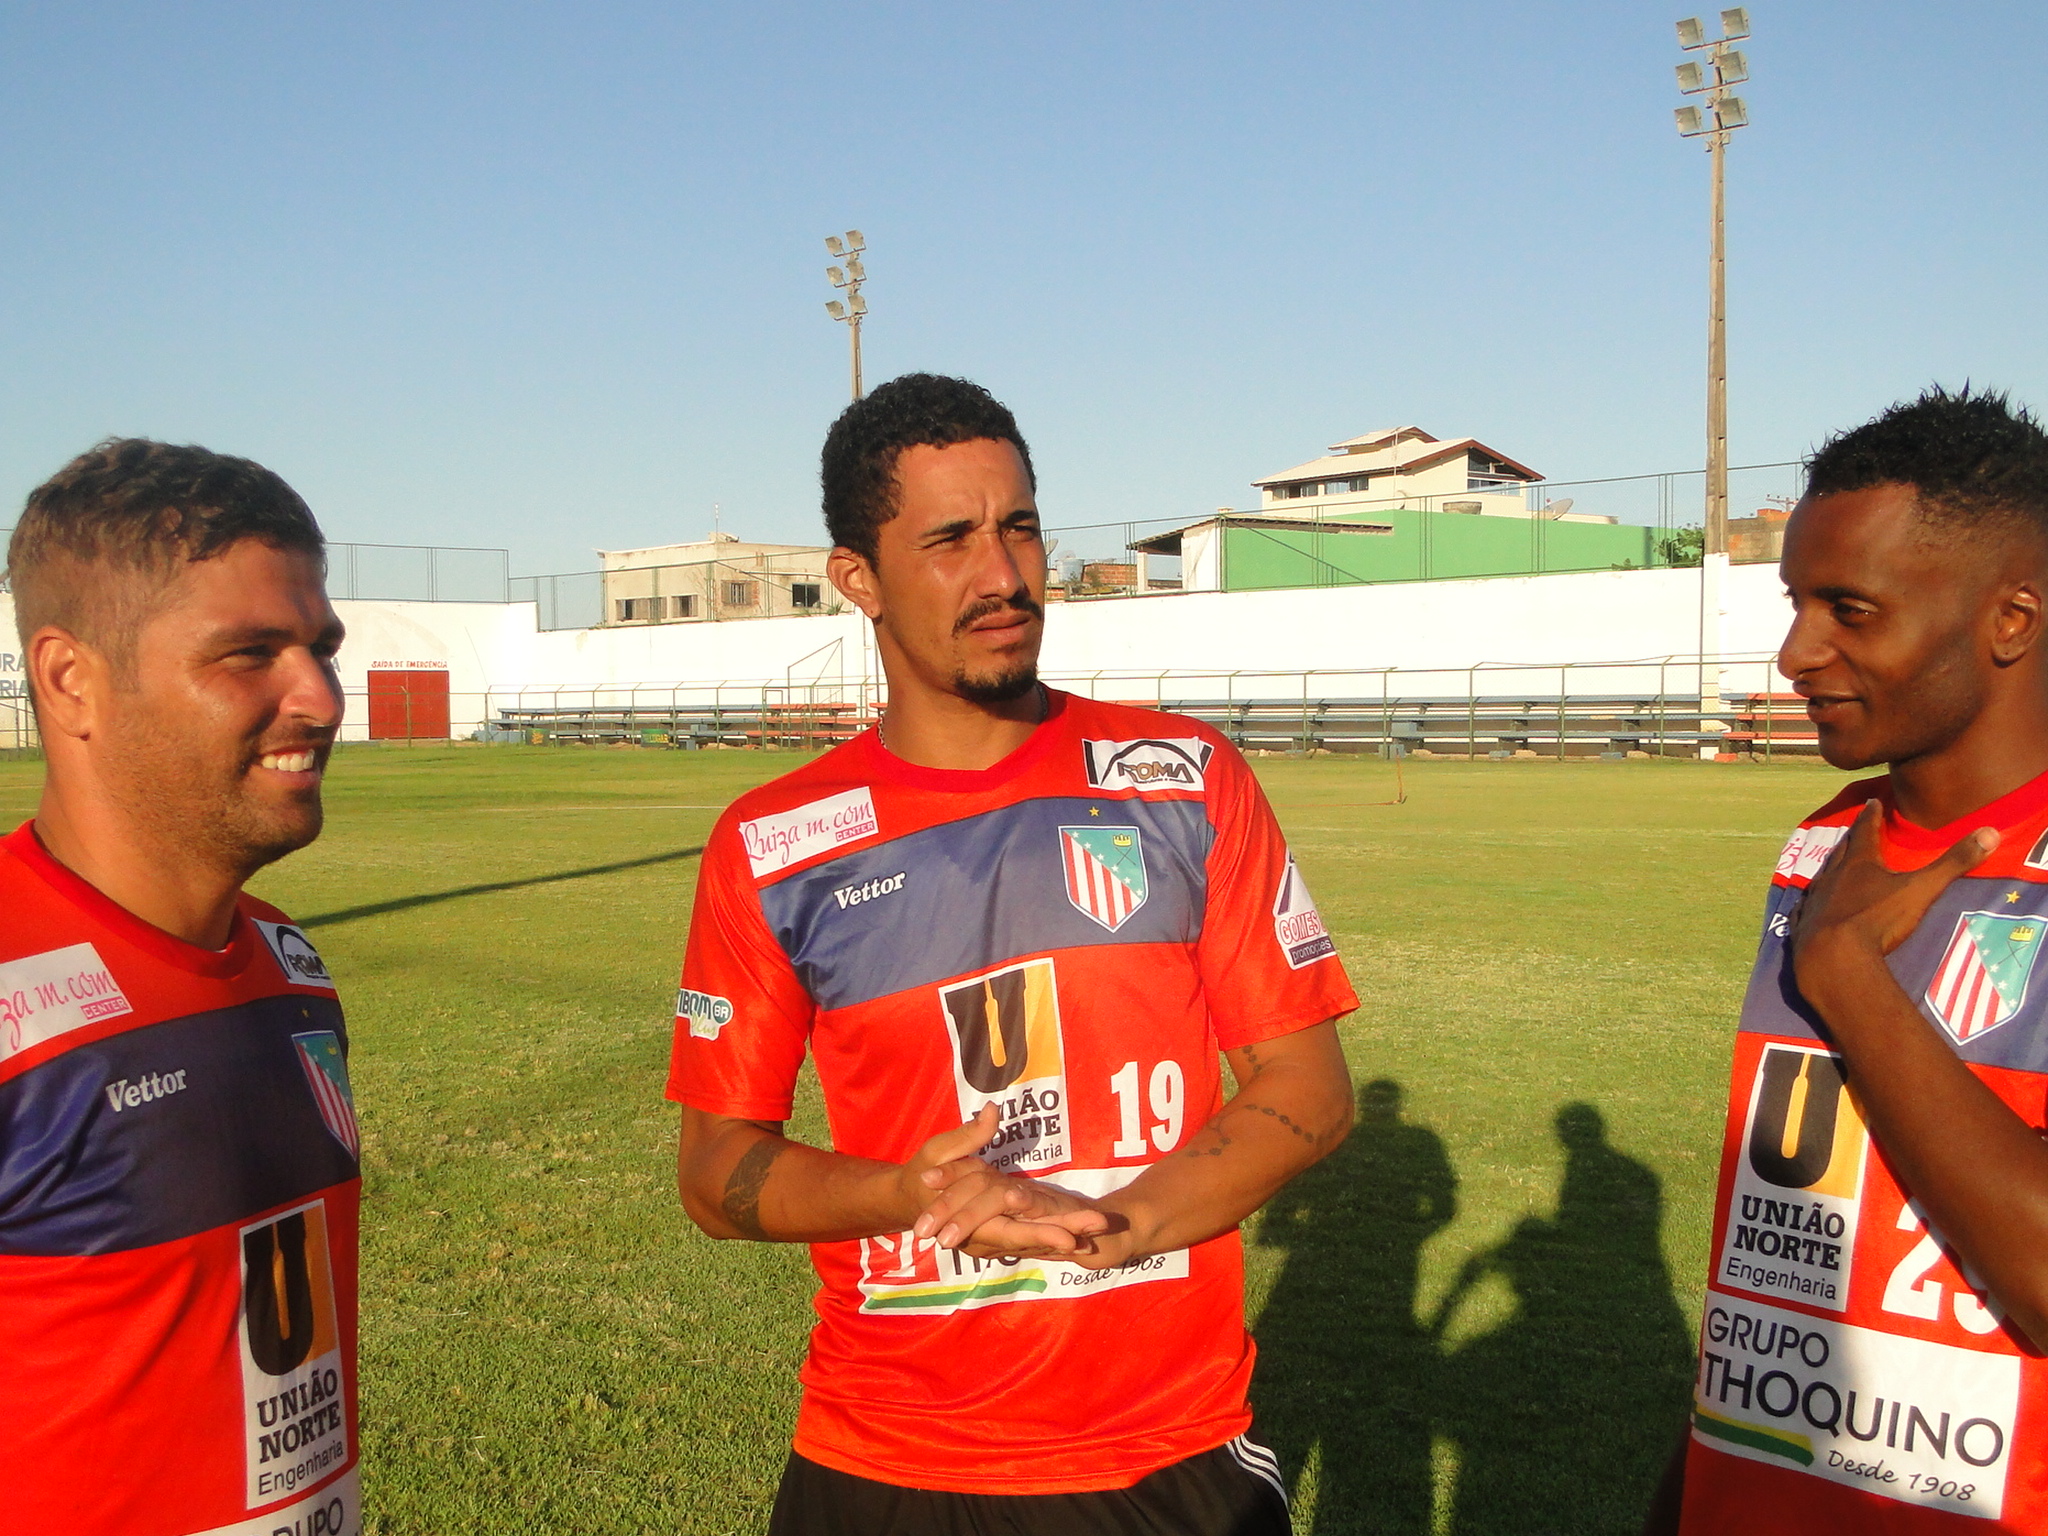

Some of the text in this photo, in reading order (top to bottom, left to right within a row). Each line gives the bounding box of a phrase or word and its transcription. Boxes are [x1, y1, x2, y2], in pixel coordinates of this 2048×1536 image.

[1117, 761, 1195, 783] ROMA
[744, 822, 801, 865] Luiza
[836, 821, 875, 841] CENTER
[834, 871, 906, 910] Vettor
[1279, 910, 1321, 945] GOMES
[83, 997, 129, 1019] CENTER
[713, 1004, 730, 1019] BR
[105, 1067, 187, 1112] Vettor
[1110, 1060, 1185, 1159] 19
[979, 1114, 1061, 1156] ORTE
[1742, 1194, 1845, 1239] UNIÃO
[1733, 1224, 1842, 1271] NORTE
[1726, 1256, 1837, 1300] Engenharia
[1707, 1306, 1830, 1368] GRUPO
[257, 1368, 338, 1428] UNIÃO
[1704, 1350, 2004, 1467] THOQUINO
[258, 1401, 340, 1464] NORTE
[258, 1440, 344, 1496] Engenharia
[1828, 1450, 1976, 1501] Desde 1908
